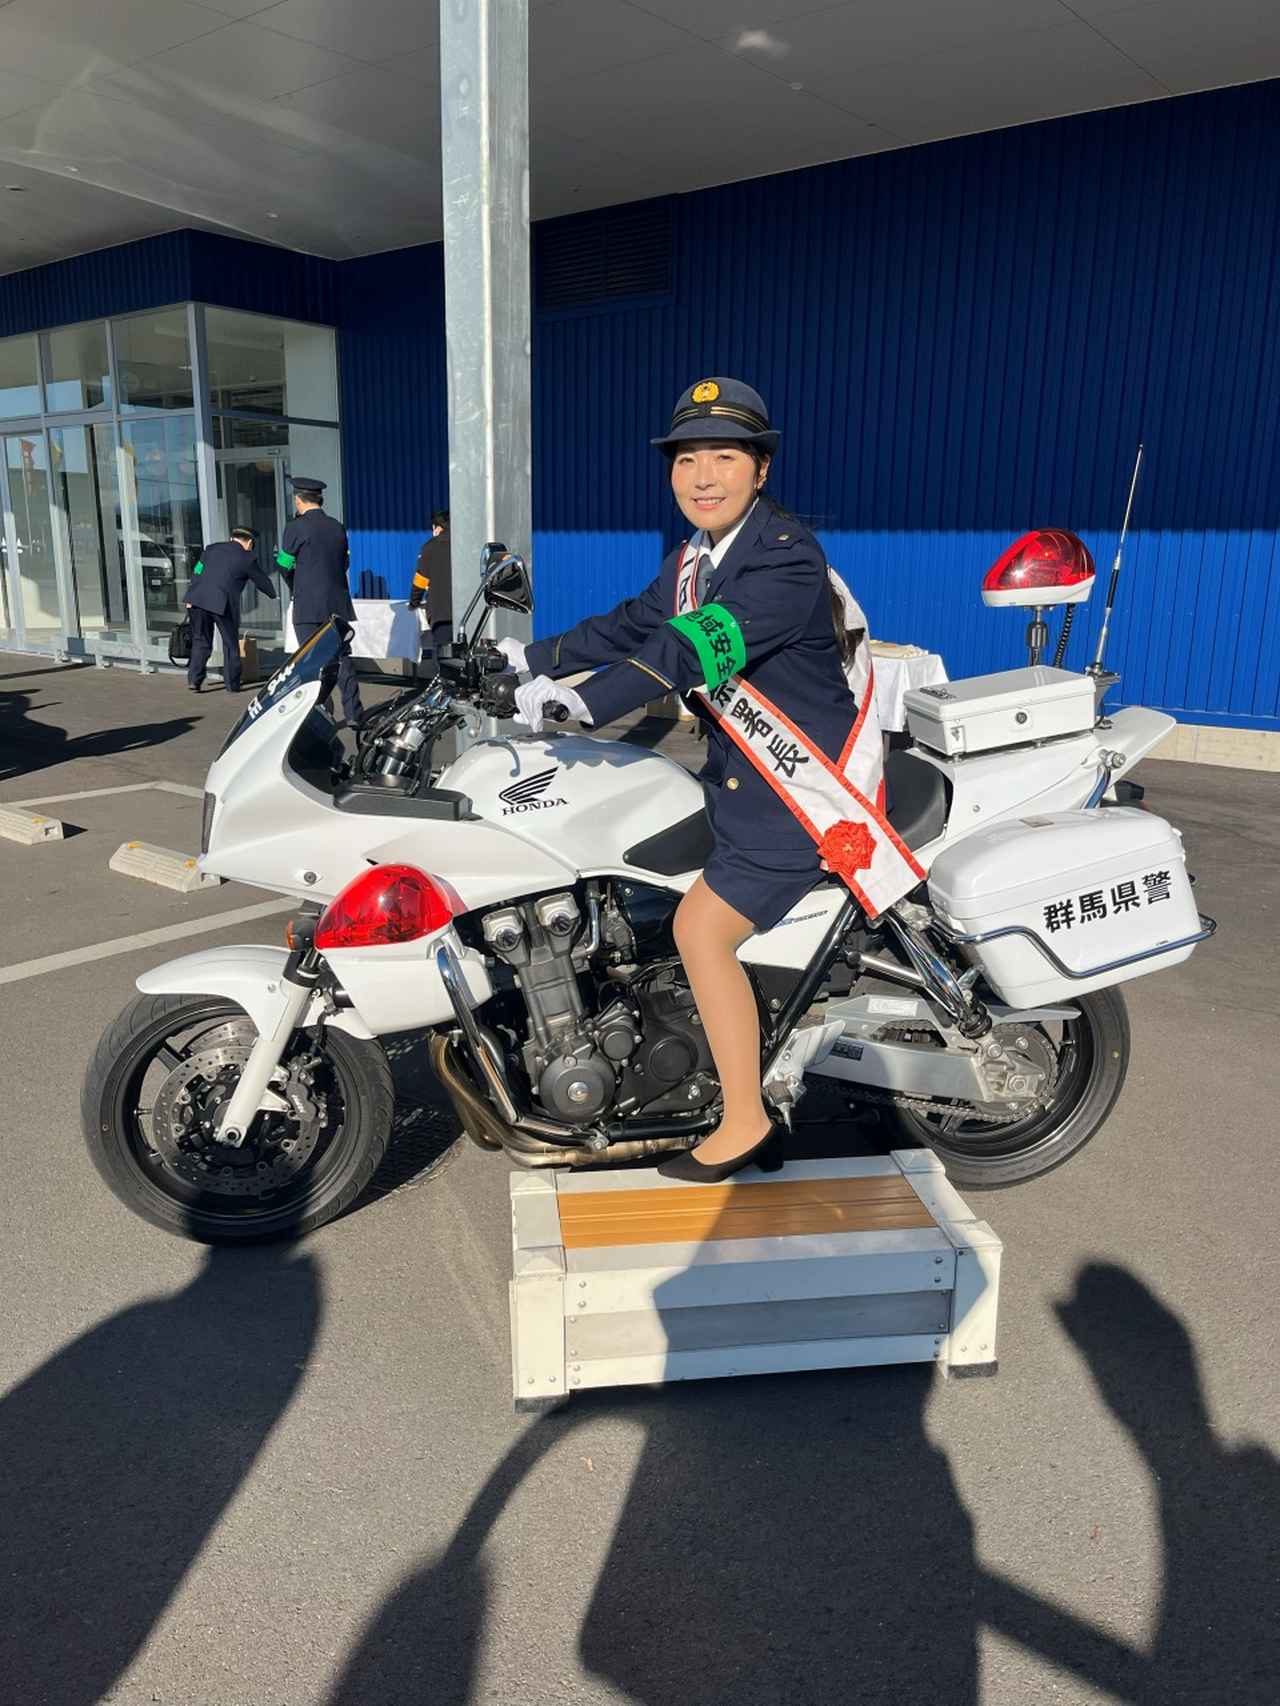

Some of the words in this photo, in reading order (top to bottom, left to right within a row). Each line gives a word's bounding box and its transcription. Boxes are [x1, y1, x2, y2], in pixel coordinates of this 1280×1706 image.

[501, 797, 569, 816] HONDA
[1043, 870, 1172, 933] 群馬県警
